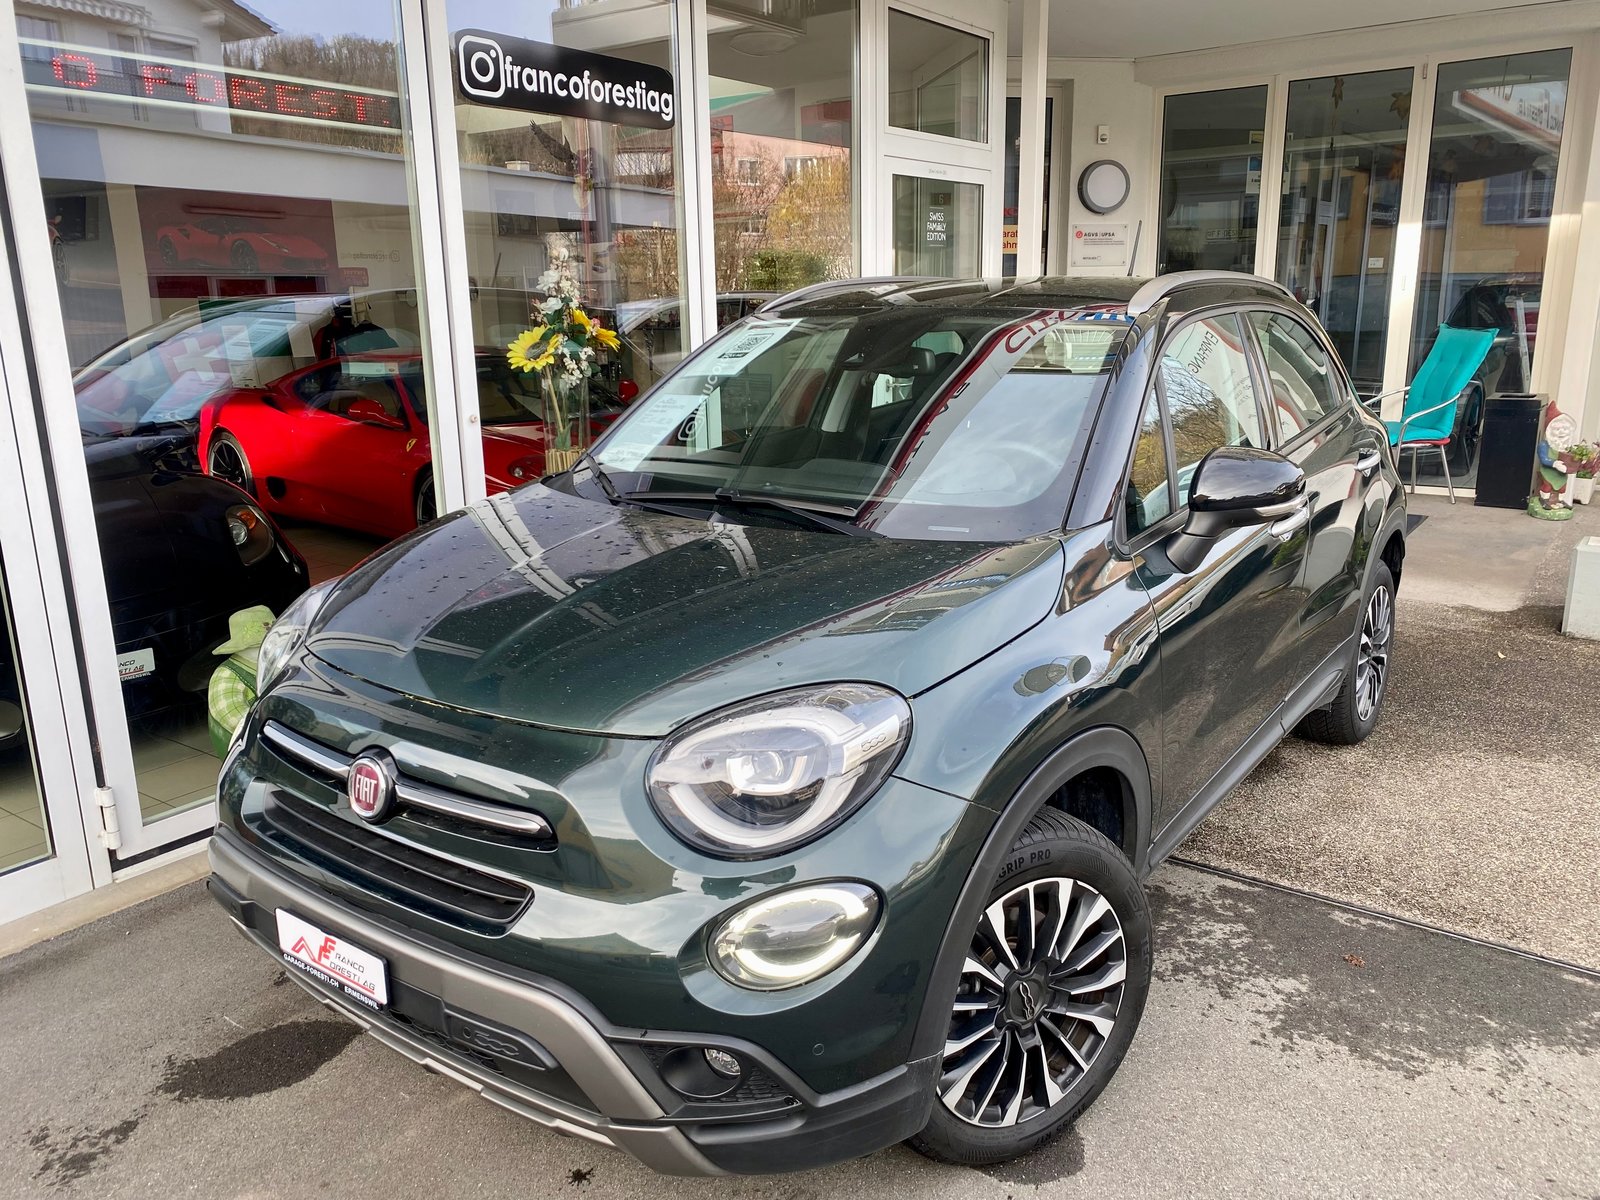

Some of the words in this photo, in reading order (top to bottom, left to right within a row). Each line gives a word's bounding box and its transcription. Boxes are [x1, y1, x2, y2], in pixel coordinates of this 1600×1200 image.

[504, 55, 674, 122] francoforestiag
[929, 212, 944, 222] SWISS
[926, 232, 946, 241] EDITION
[355, 773, 377, 804] FIAT
[1030, 848, 1051, 864] PRO
